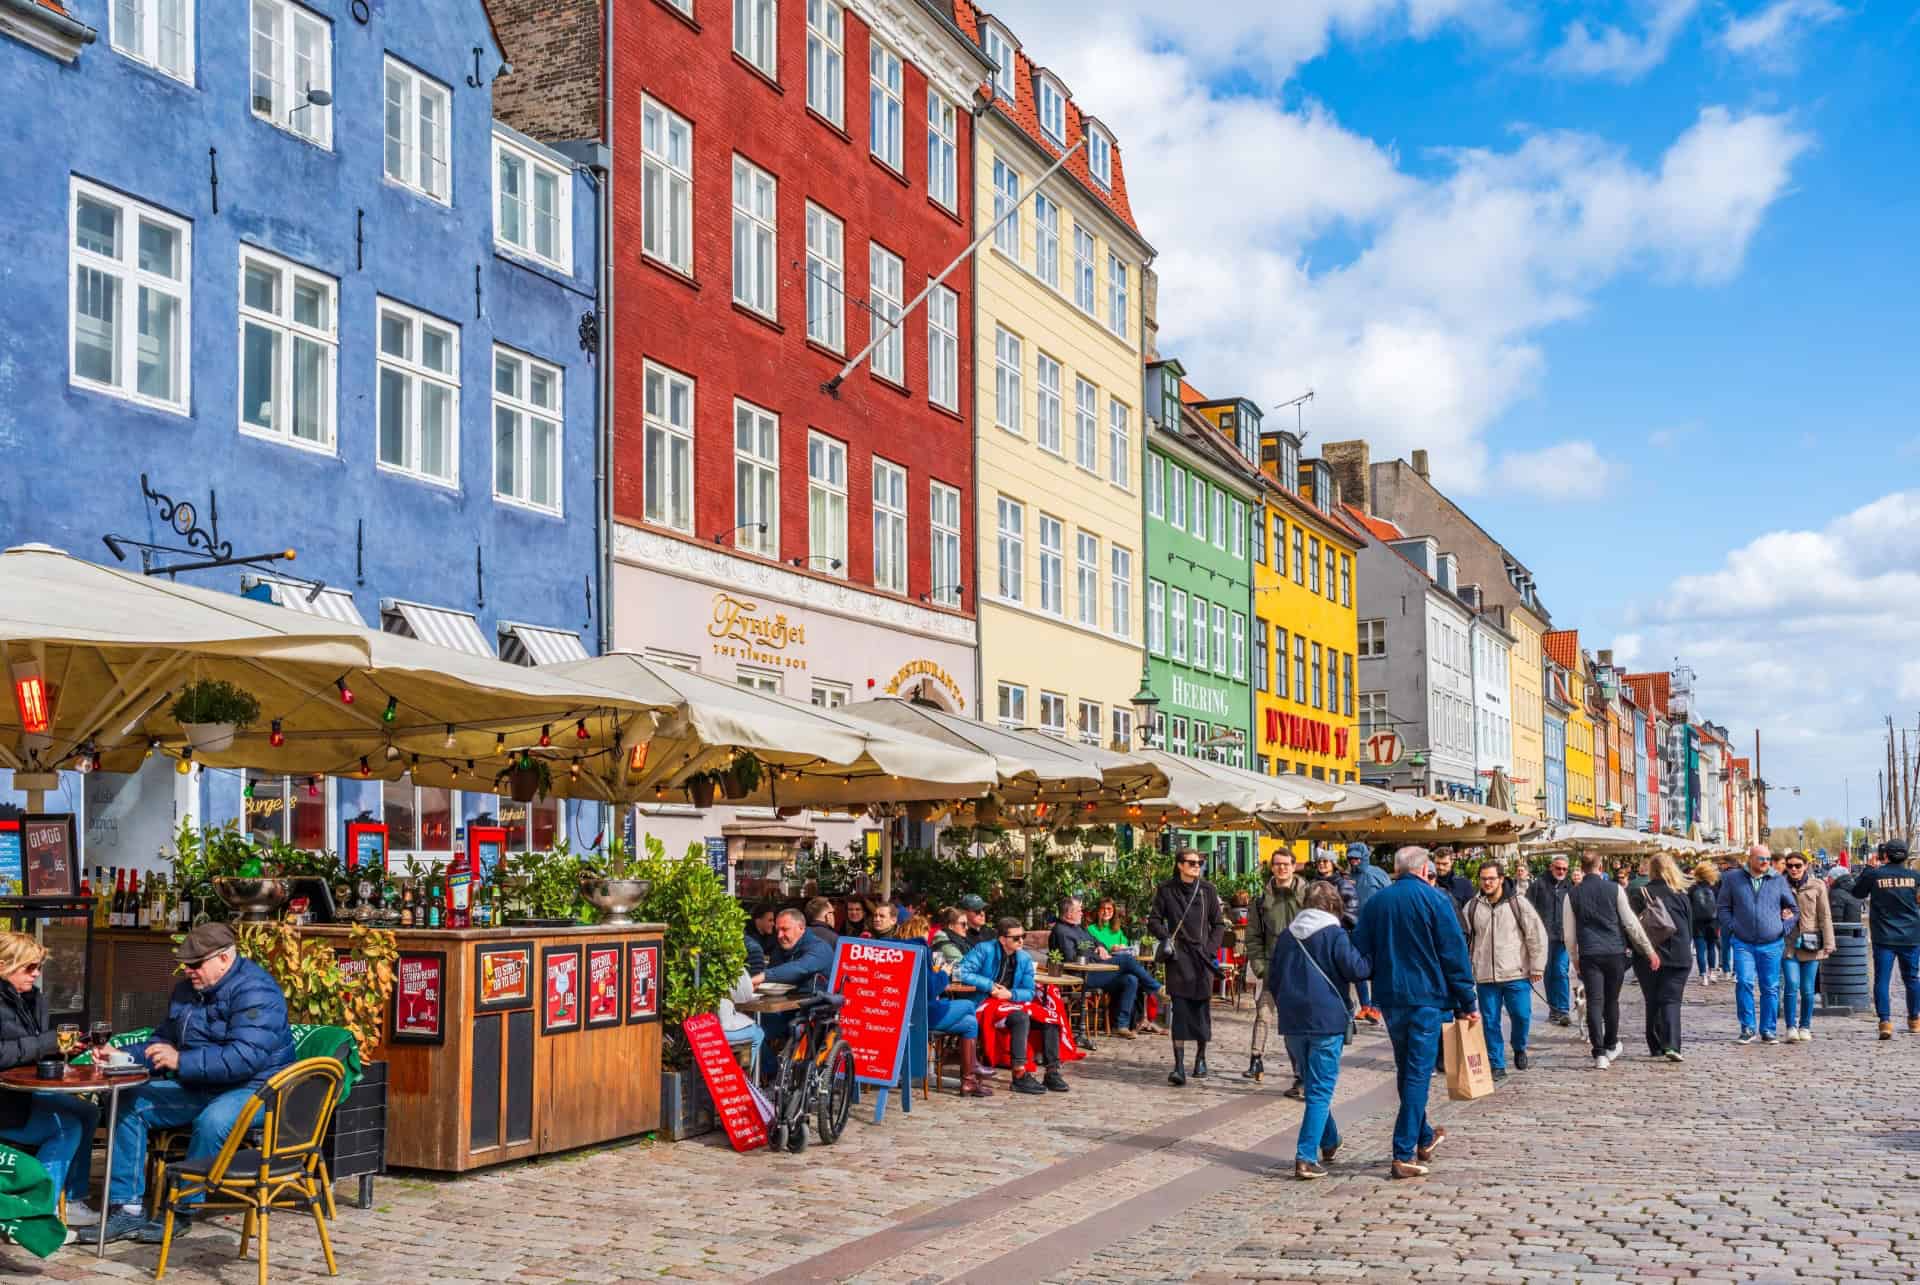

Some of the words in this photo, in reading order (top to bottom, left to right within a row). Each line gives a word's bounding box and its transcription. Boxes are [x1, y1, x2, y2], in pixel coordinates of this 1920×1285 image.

[178, 506, 191, 531] 9
[713, 643, 736, 657] THE
[740, 644, 781, 666] TINDER
[785, 657, 807, 670] BOX
[1173, 674, 1229, 717] HEERING
[1266, 707, 1330, 757] NYHAVN
[1334, 727, 1349, 760] 17
[1368, 735, 1396, 764] 17
[1878, 879, 1894, 888] THE
[1895, 878, 1915, 888] LAND
[591, 953, 611, 970] APEROL
[850, 944, 904, 964] BURGERS
